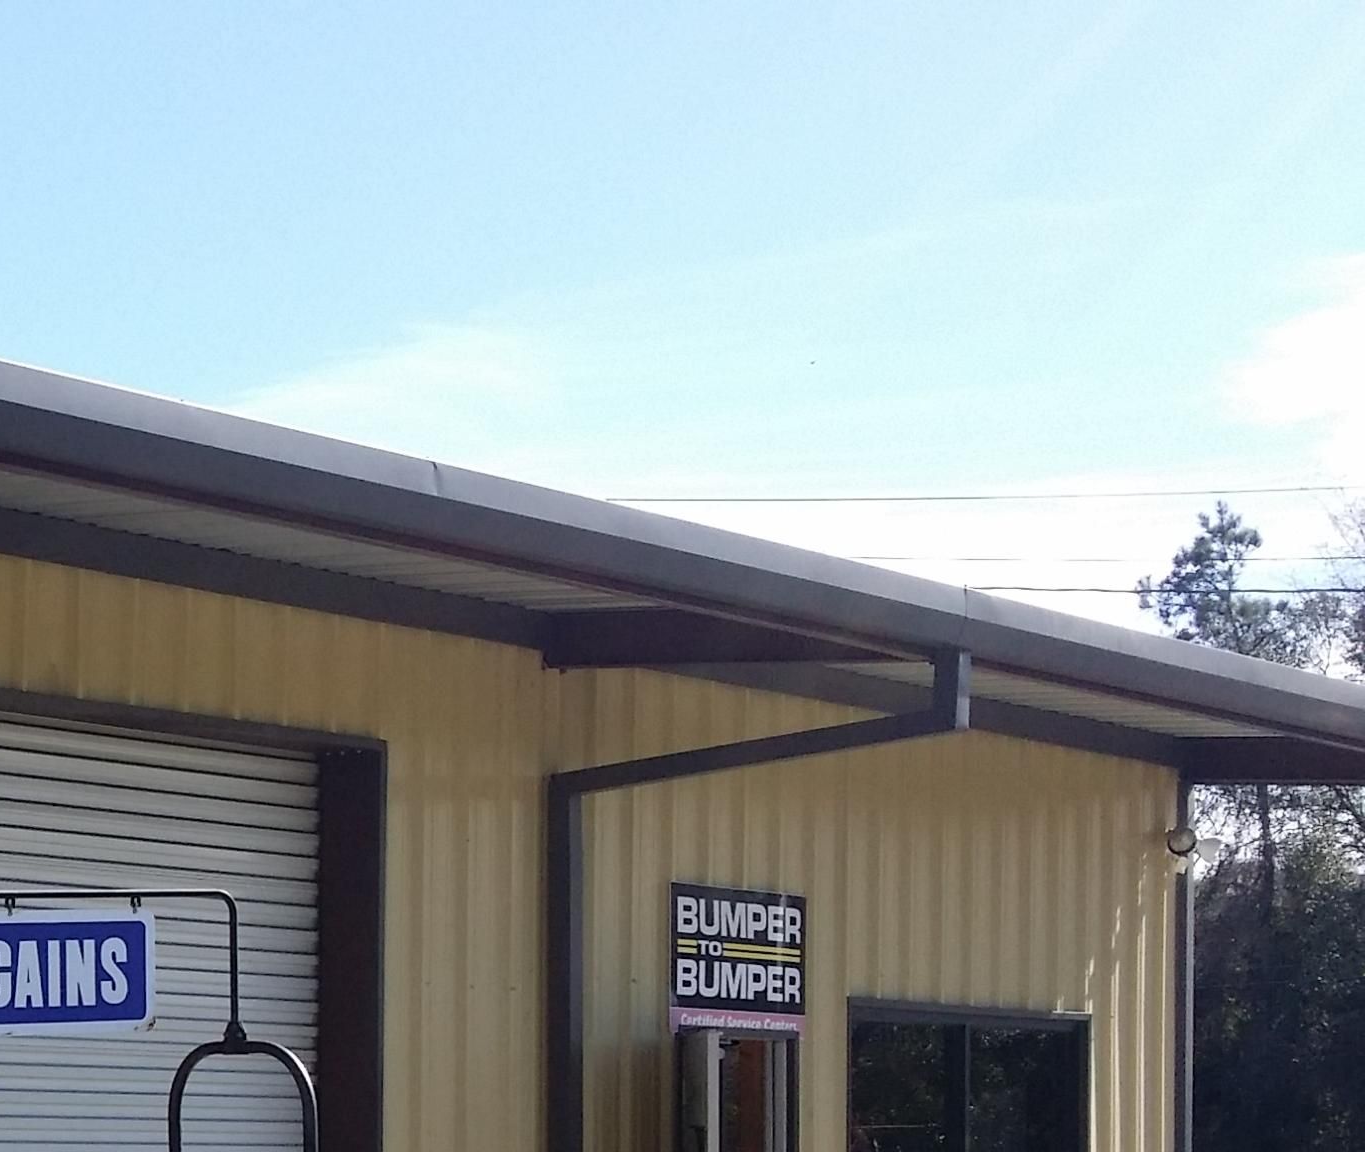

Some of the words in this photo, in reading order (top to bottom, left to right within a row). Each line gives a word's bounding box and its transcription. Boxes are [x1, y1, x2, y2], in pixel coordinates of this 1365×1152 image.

[676, 896, 802, 944] BUMPER
[698, 940, 722, 956] TO
[676, 958, 801, 1003] BUMPER
